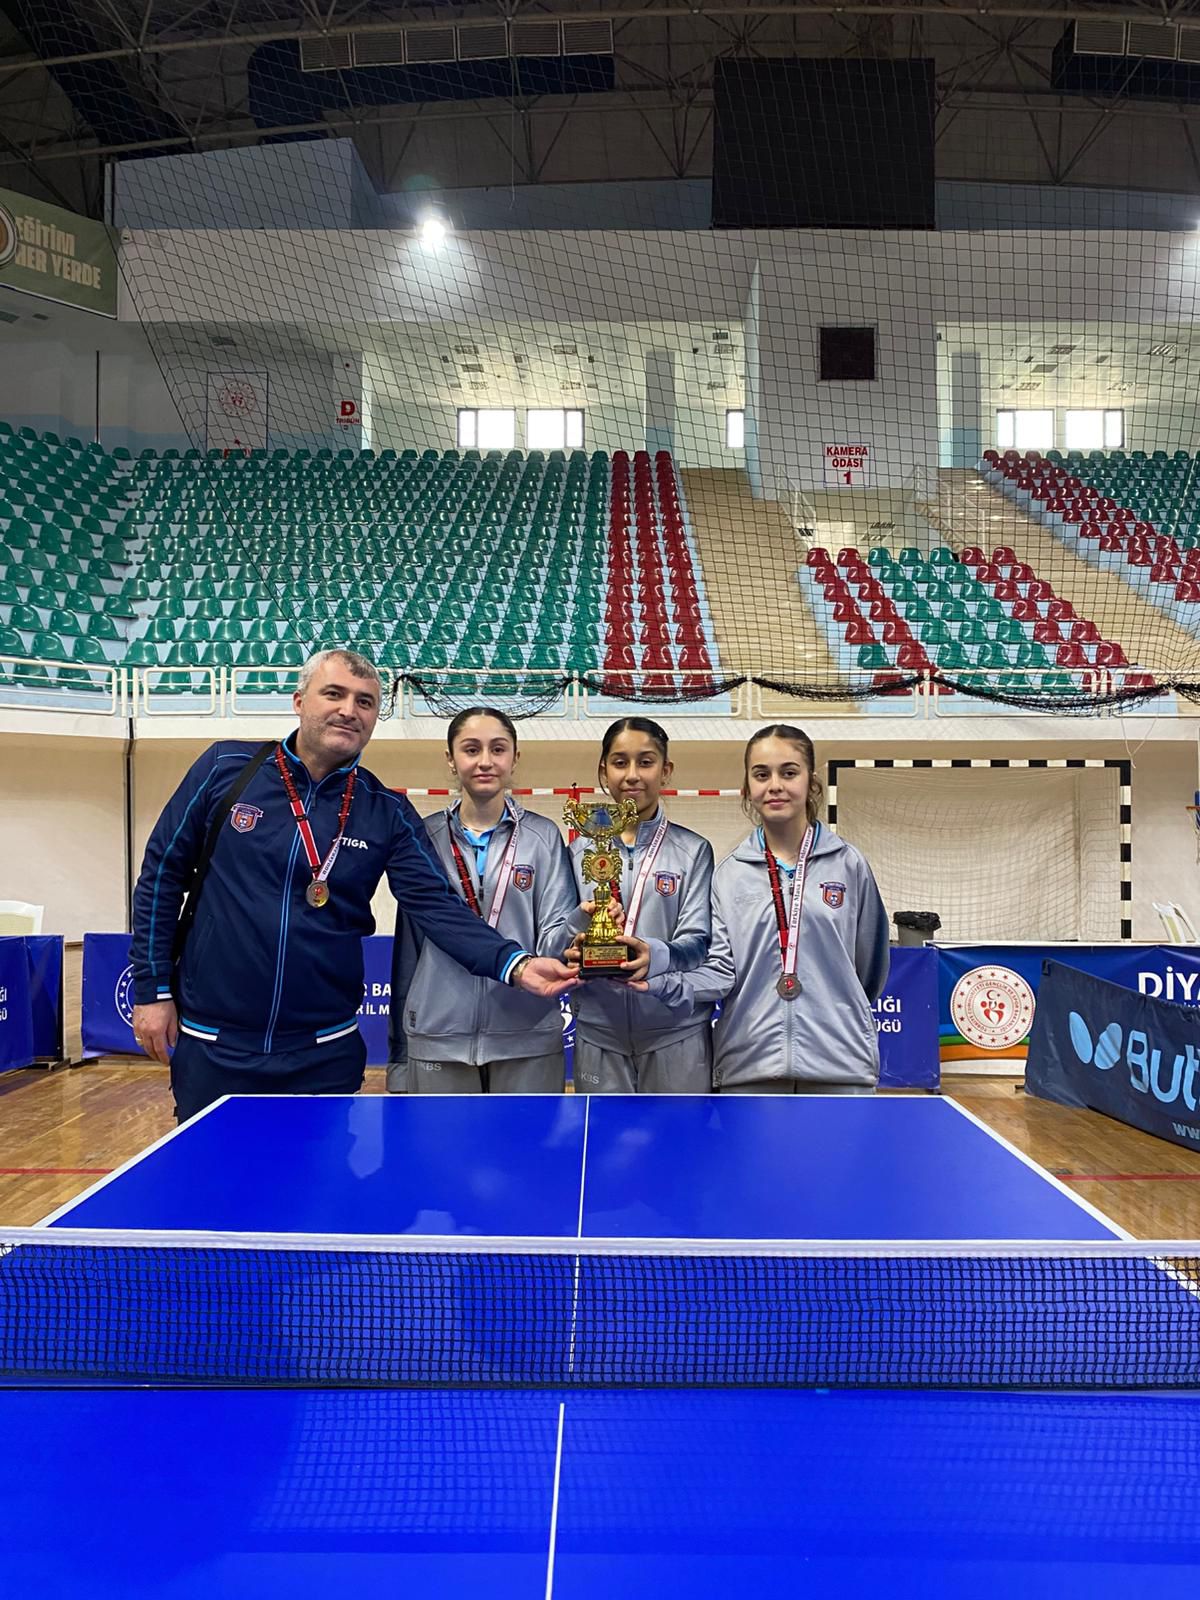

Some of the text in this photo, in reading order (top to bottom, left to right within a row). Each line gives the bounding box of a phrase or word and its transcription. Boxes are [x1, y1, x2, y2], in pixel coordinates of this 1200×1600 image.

[15, 242, 101, 290] HER YERDE
[340, 400, 356, 417] D
[826, 446, 868, 456] KAMERA
[843, 471, 852, 485] 1
[332, 836, 369, 850] TIGA
[1137, 965, 1200, 1000] DİY
[372, 983, 391, 997] BA
[366, 1002, 377, 1015] İL
[378, 1004, 390, 1015] M
[1127, 1029, 1200, 1112] But
